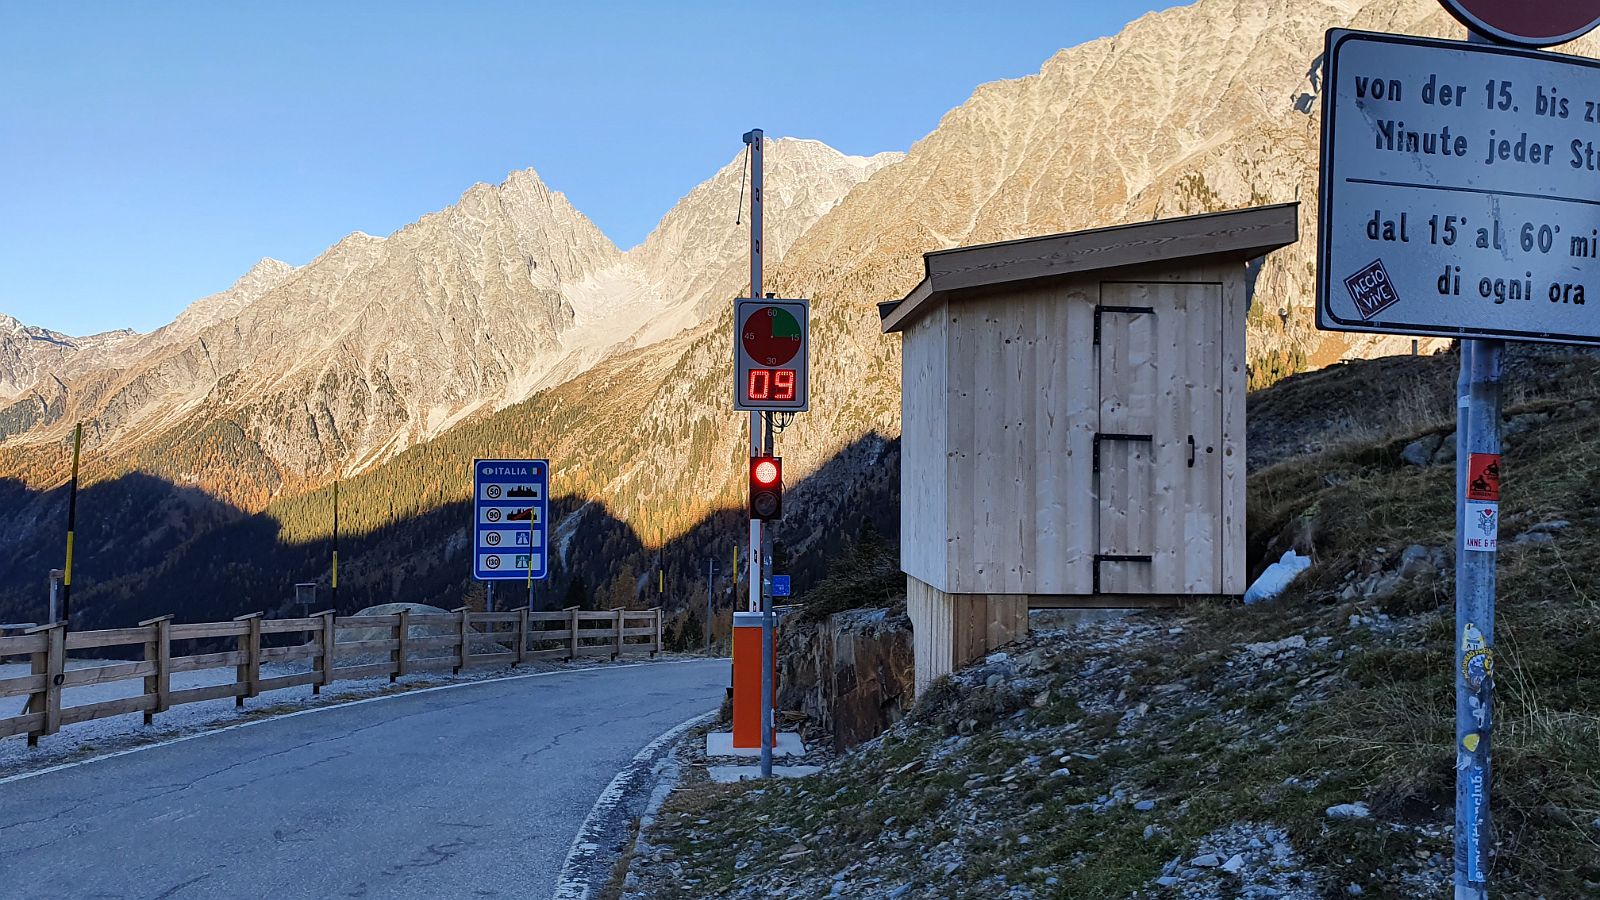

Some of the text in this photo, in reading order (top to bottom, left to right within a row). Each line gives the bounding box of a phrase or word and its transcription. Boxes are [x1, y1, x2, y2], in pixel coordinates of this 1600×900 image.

[1355, 76, 1402, 101] von
[1421, 74, 1467, 107] der
[1485, 79, 1519, 112] 15.
[1535, 85, 1569, 119] bis
[1375, 119, 1468, 157] Minute
[1485, 129, 1554, 165] jeder
[1366, 210, 1409, 242] dal
[1428, 214, 1467, 246] 15'
[1475, 219, 1502, 250] al
[1520, 222, 1561, 254] 60'
[1437, 264, 1586, 305] di ogni ora
[767, 309, 778, 317] 60
[744, 332, 800, 341] 45 15
[767, 357, 777, 365] 30
[749, 371, 794, 399] 09
[494, 467, 528, 475] ITALIA
[489, 511, 499, 519] 90
[487, 558, 499, 566] 130
